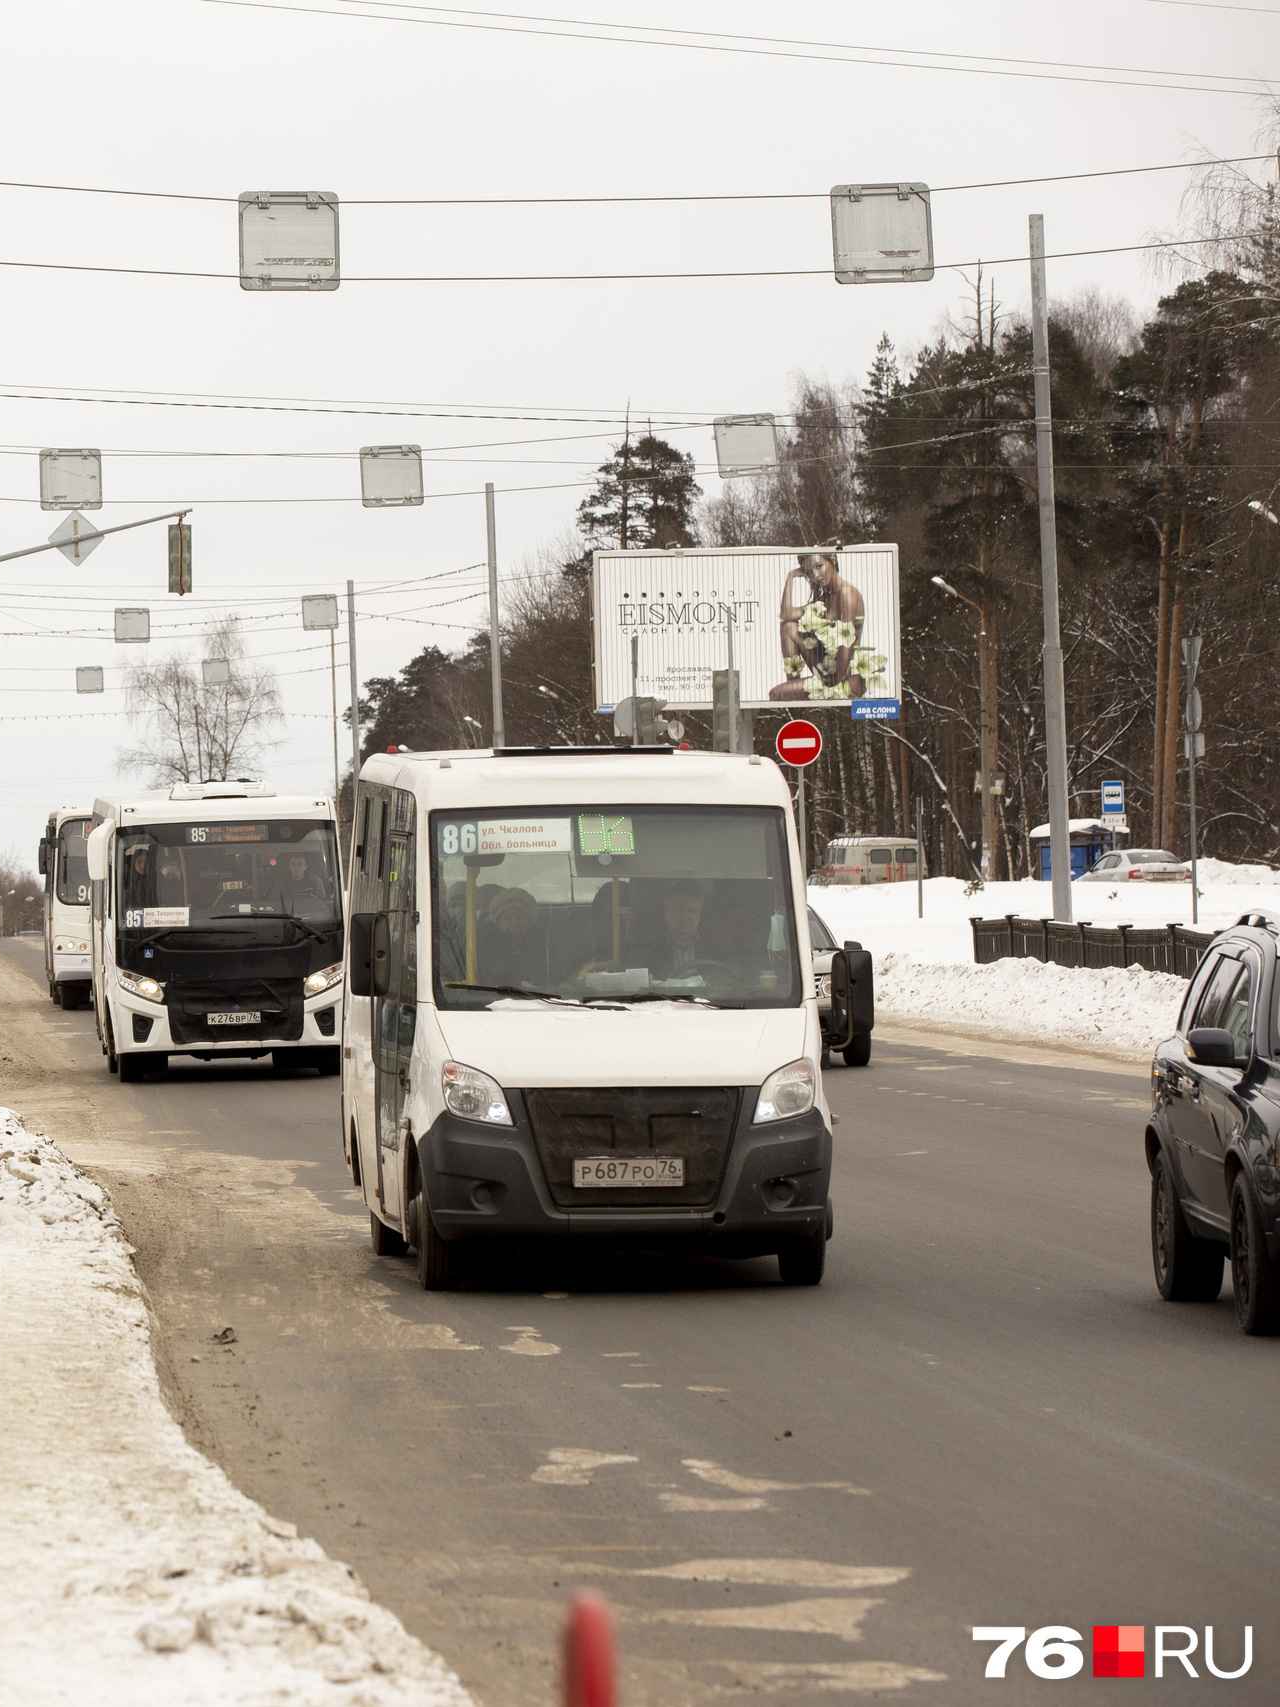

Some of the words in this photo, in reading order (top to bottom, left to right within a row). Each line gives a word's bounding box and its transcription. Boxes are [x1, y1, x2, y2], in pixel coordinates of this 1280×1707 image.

[618, 601, 759, 626] EISMONT
[622, 626, 668, 635] САЛОН
[482, 827, 496, 835] ул.
[500, 825, 544, 834] Чкалова
[578, 813, 635, 852] 86
[443, 824, 477, 854] 86
[481, 841, 504, 850] Обл.
[507, 839, 558, 849] больница
[249, 1012, 258, 1020] 76
[582, 1162, 655, 1180] Р687РО
[659, 1160, 677, 1174] 76
